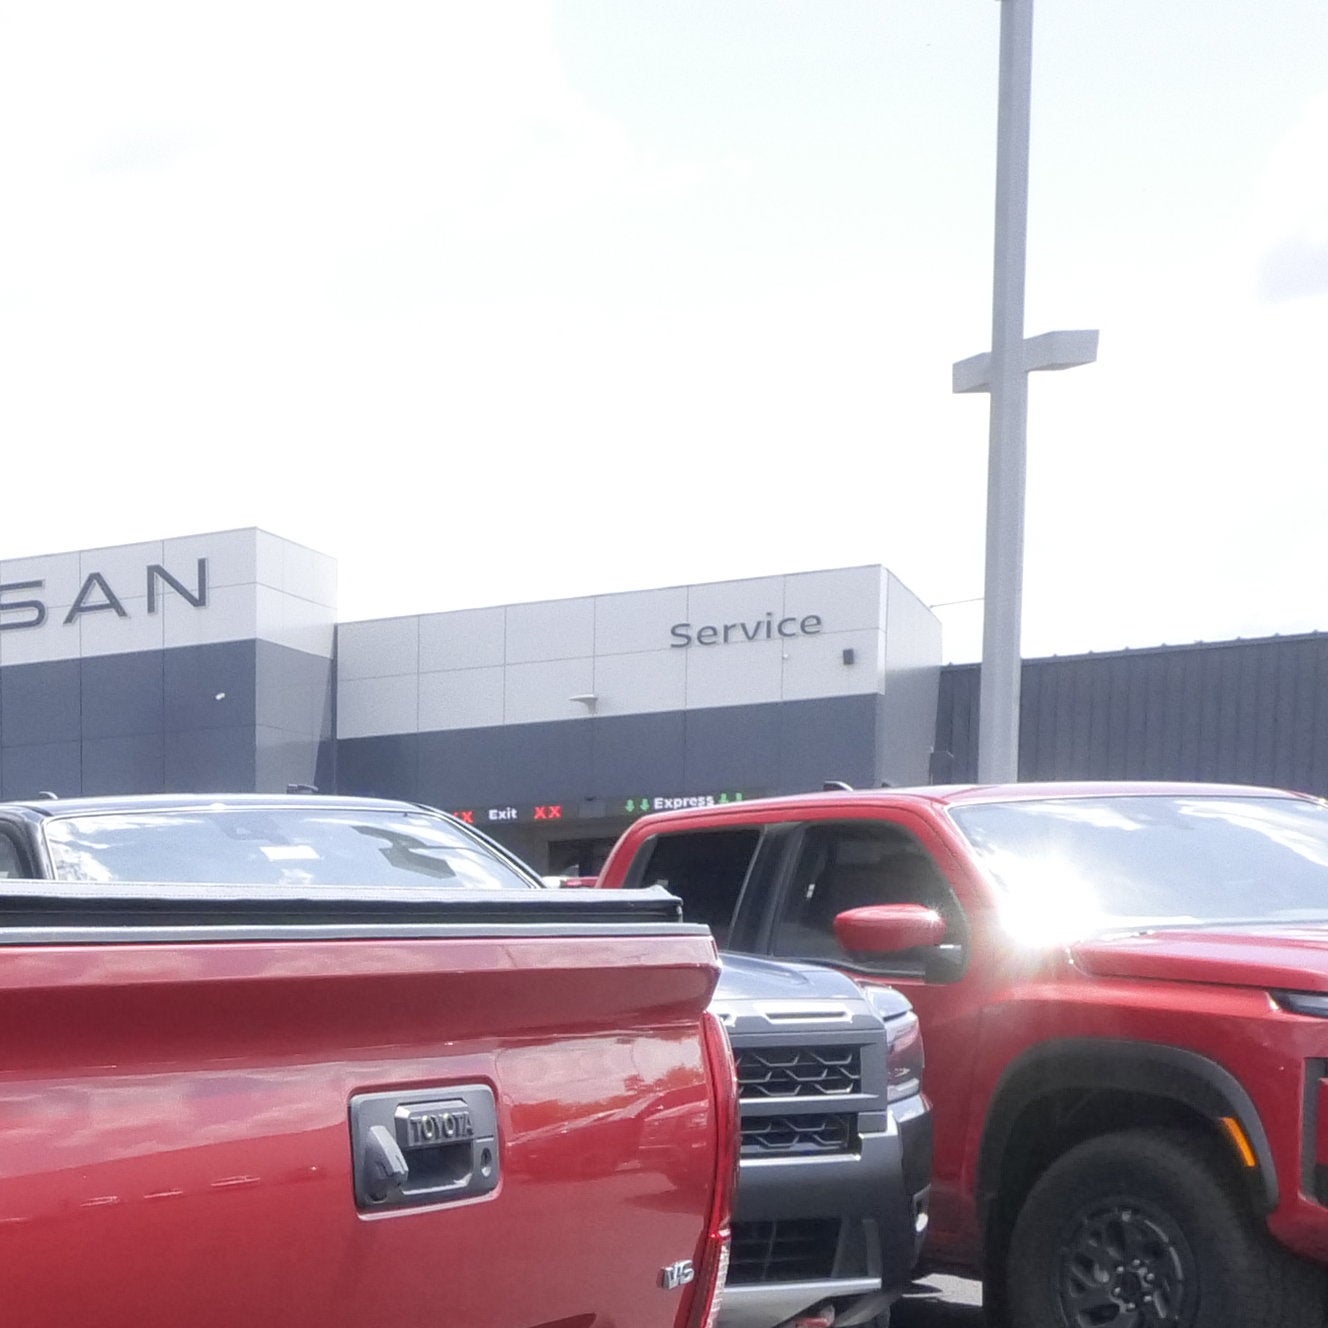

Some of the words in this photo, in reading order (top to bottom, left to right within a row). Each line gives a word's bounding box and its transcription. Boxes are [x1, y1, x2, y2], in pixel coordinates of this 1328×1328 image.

[669, 612, 823, 649] Service
[488, 806, 518, 821] Exit
[653, 795, 715, 810] Express
[409, 1111, 474, 1145] TOYOTA
